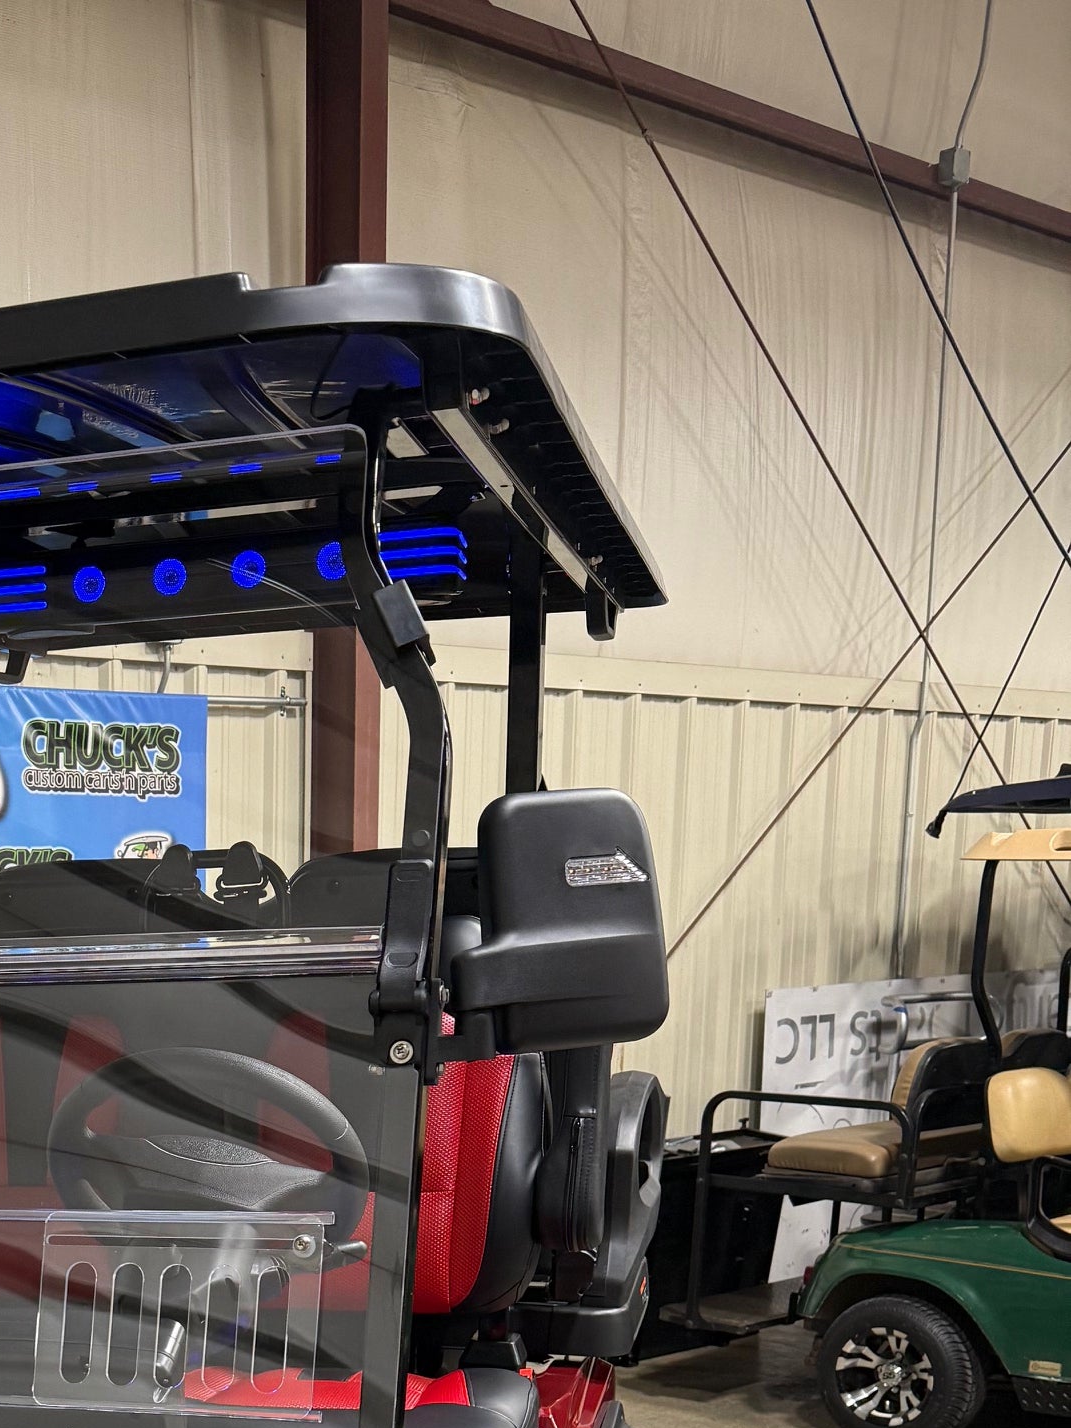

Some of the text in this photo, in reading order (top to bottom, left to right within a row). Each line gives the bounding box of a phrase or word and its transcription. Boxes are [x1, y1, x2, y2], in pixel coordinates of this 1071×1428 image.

[23, 720, 180, 773] CHUCK'S
[24, 769, 84, 790] custom
[137, 771, 179, 797] parts
[775, 1013, 836, 1064] LLC
